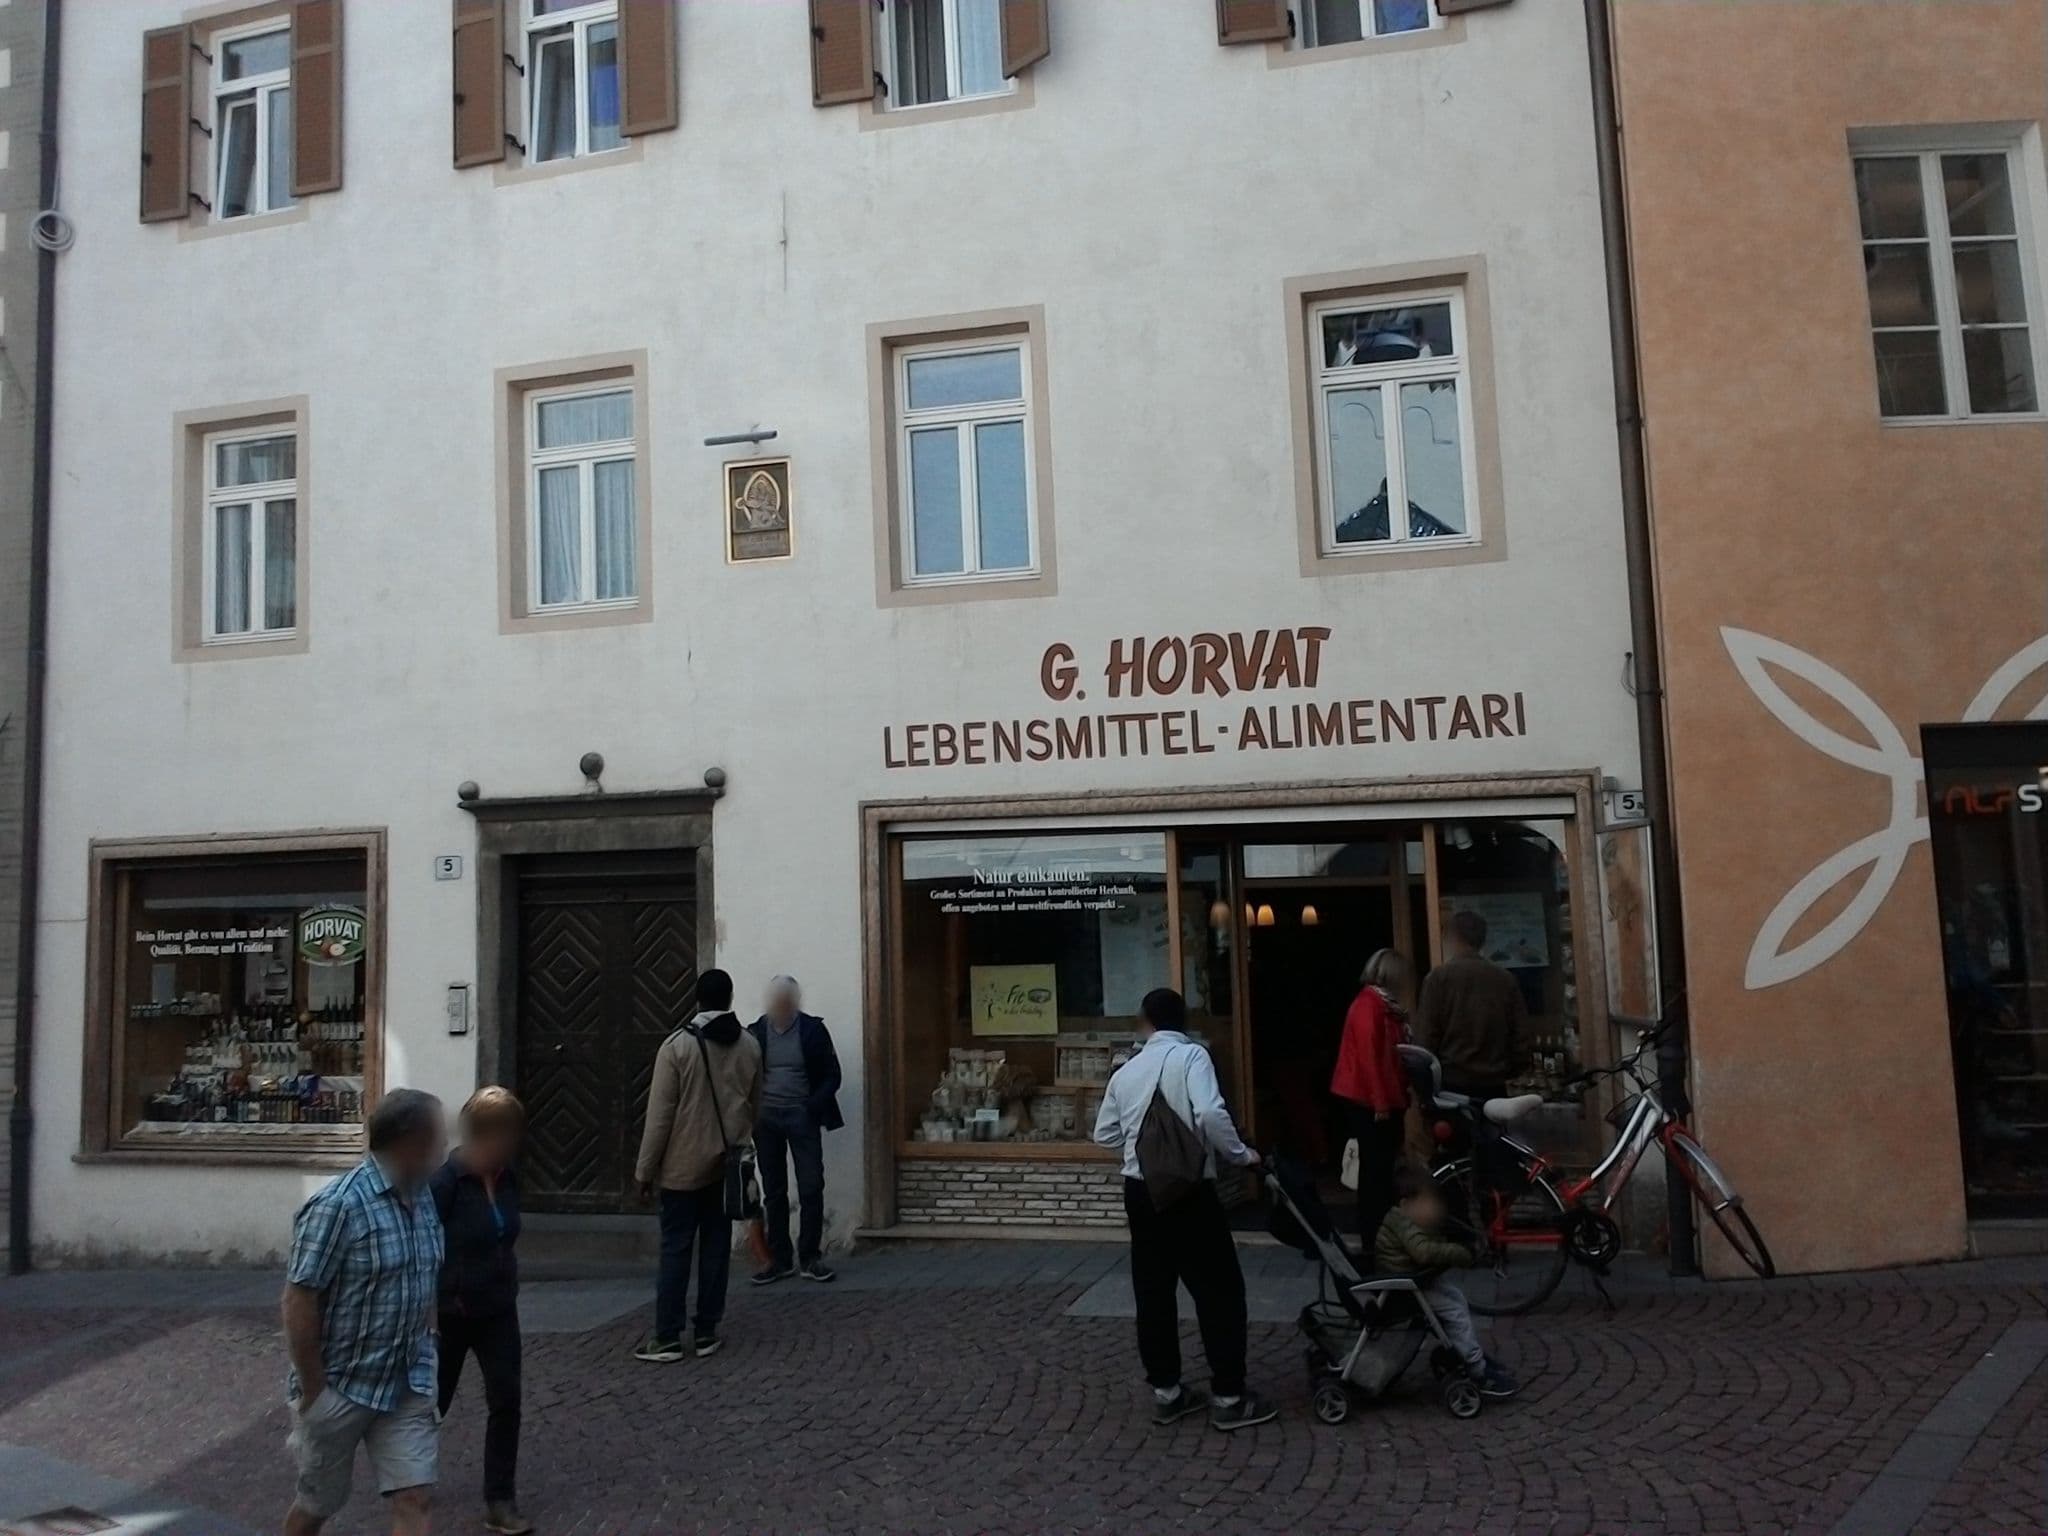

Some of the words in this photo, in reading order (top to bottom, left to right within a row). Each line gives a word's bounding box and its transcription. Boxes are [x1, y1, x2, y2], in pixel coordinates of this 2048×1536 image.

[1040, 641, 1087, 701] G.
[1104, 626, 1333, 698] HORVAT
[444, 858, 453, 872] 5
[973, 867, 1013, 885] Natur
[1017, 865, 1090, 884] einkaufen.
[958, 888, 994, 899] Sortiment
[1007, 887, 1046, 898] Produkten
[1001, 900, 1016, 911] und
[157, 929, 183, 942] Horvat
[249, 927, 265, 938] und
[304, 918, 362, 943] HORVAT
[221, 941, 236, 953] und
[237, 941, 274, 954] Tradition
